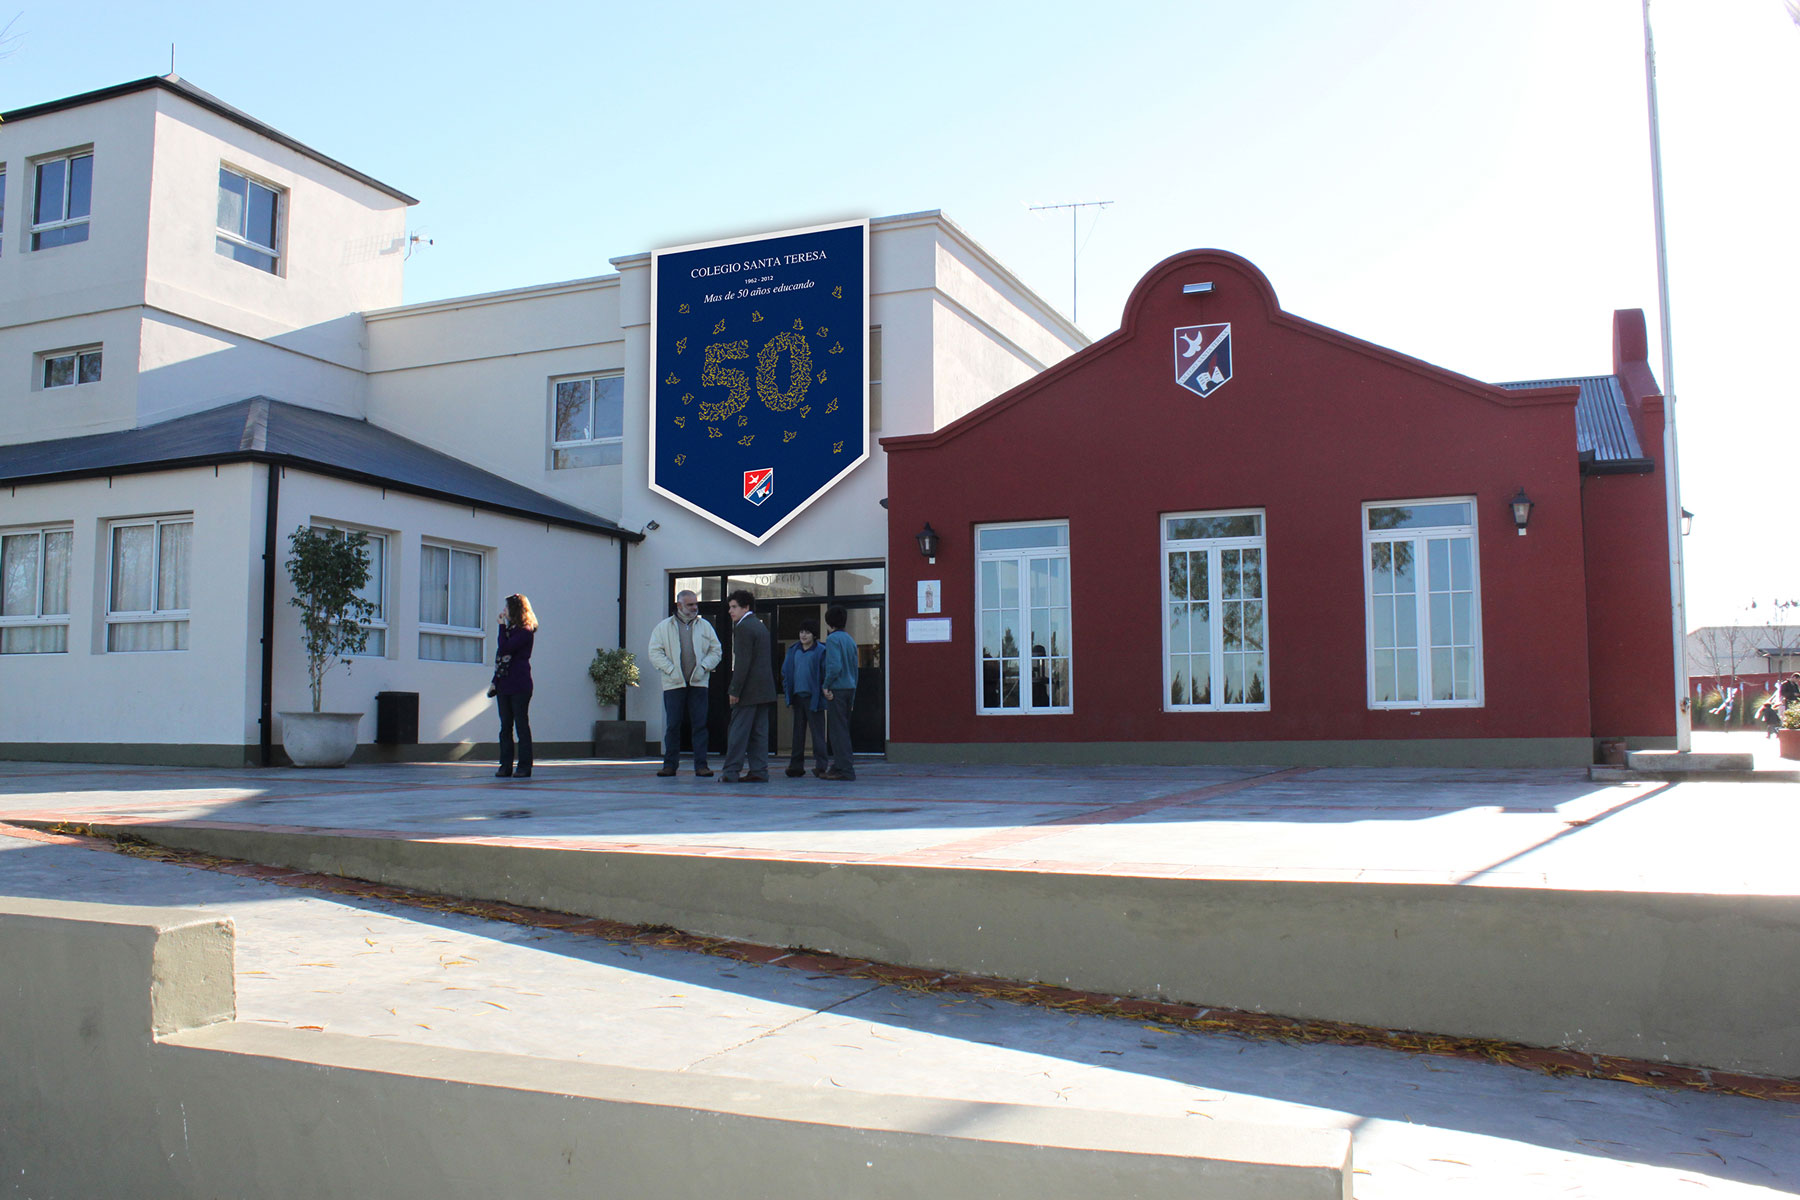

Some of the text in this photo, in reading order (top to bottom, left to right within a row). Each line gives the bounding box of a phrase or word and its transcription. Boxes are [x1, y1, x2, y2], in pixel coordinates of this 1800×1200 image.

[690, 250, 827, 279] COLEGIO SANTA TERESA
[704, 279, 815, 304] Mas de 50 años educando
[698, 331, 813, 421] 50
[754, 572, 801, 584] COLEGIO
